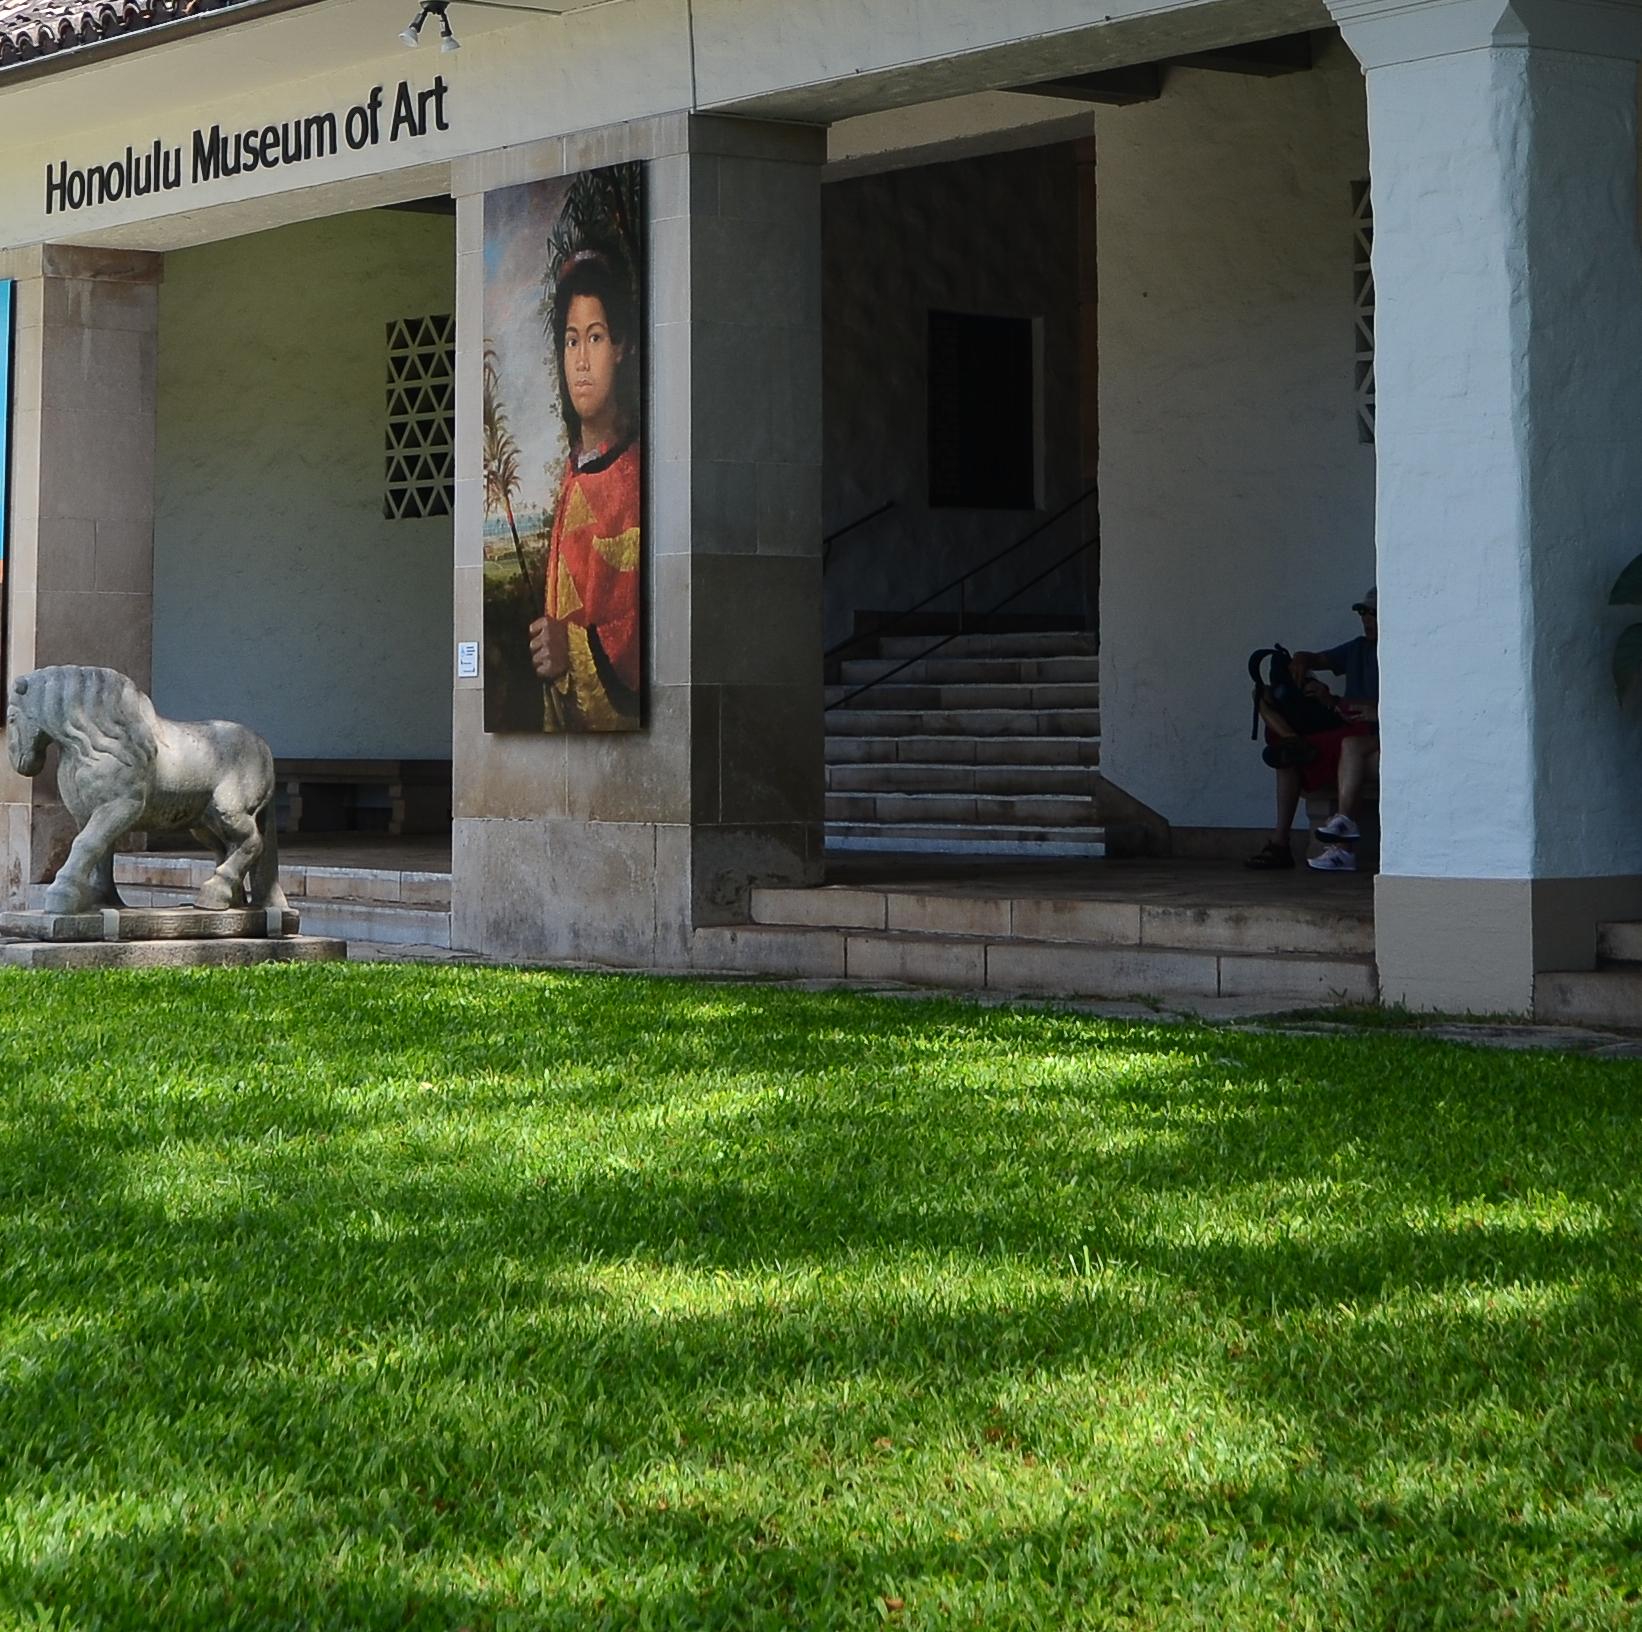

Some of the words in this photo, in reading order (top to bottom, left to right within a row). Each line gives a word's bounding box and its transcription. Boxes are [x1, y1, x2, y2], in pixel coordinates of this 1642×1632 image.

[45, 140, 181, 215] Honolulu
[192, 112, 337, 184] Museum
[345, 85, 383, 150] of
[390, 75, 450, 142] Art
